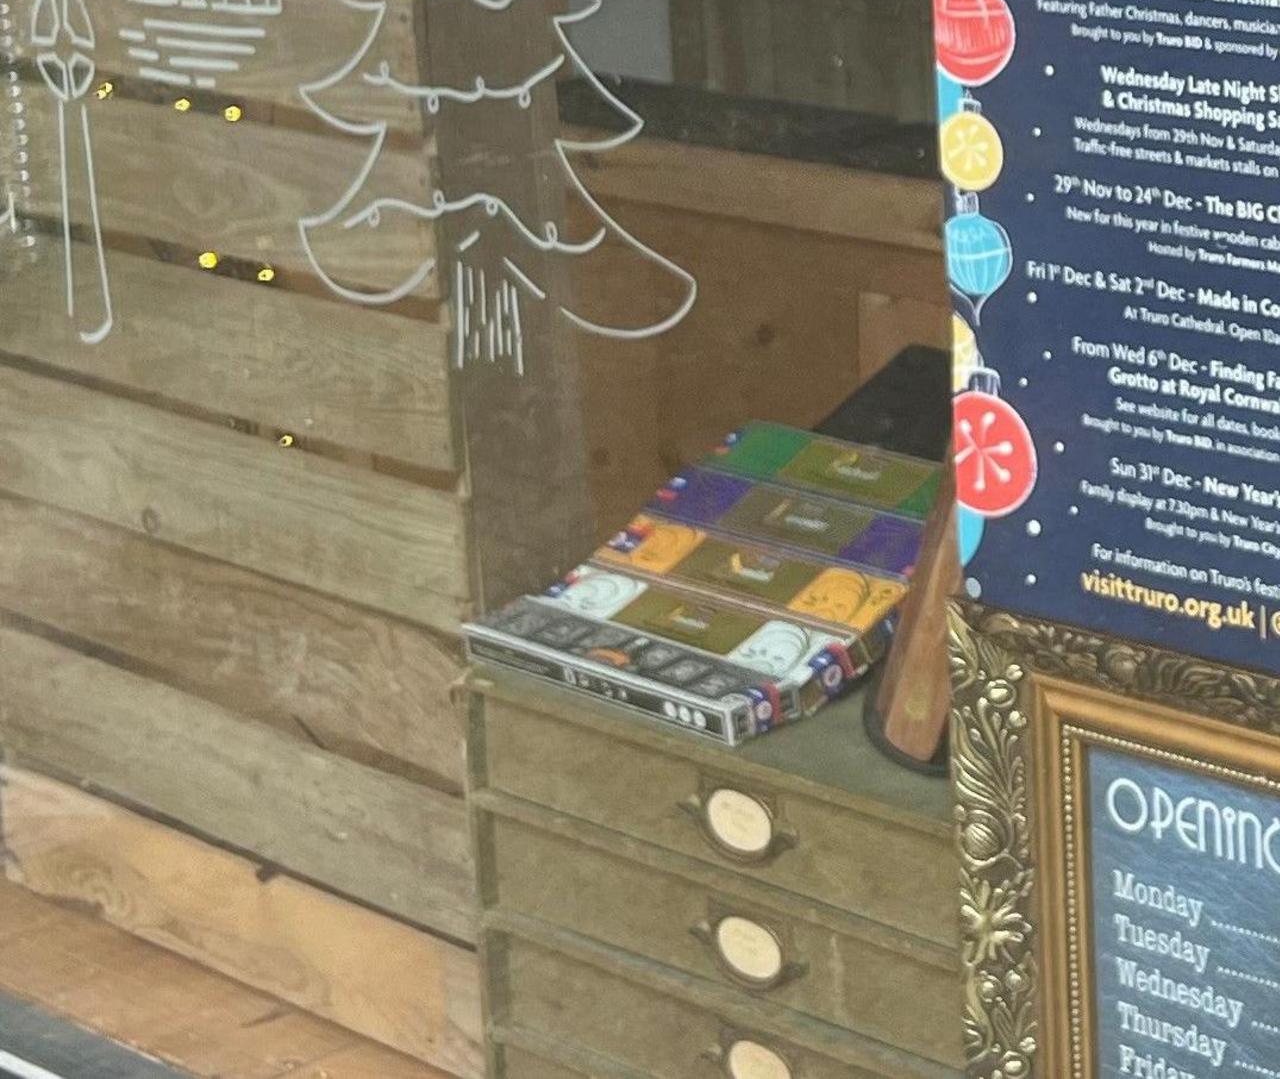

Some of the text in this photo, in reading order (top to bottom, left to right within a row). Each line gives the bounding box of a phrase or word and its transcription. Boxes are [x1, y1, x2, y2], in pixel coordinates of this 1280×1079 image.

[1087, 0, 1124, 19] Father
[1099, 64, 1186, 97] Wednesday
[1186, 74, 1221, 97] Late
[1222, 78, 1267, 105] Night
[1073, 115, 1142, 141] Wednesdays
[1141, 122, 1171, 141] from
[1171, 127, 1199, 145] 29th
[1199, 131, 1225, 148] Nov
[1225, 134, 1237, 151] &
[1101, 88, 1115, 109] &
[1115, 90, 1192, 118] Christmas
[1192, 99, 1266, 132] Shopping
[1054, 173, 1081, 194] 29th
[1082, 178, 1113, 199] Nov
[1113, 184, 1133, 203] to
[1134, 184, 1162, 205] 24th
[1162, 188, 1193, 212] Dec
[1203, 194, 1235, 217] The
[1235, 199, 1265, 222] BIG
[1026, 260, 1046, 280] Fri
[1062, 265, 1092, 288] Dec
[1093, 270, 1107, 290] &
[1107, 272, 1132, 293] Sat
[1155, 279, 1186, 303] Dec
[1196, 286, 1241, 311] Made
[1241, 293, 1258, 314] in
[1071, 335, 1110, 359] From
[1111, 342, 1146, 366] Wed
[1146, 348, 1167, 368] 6th
[1167, 351, 1199, 375] Dec
[1208, 359, 1265, 392] Finding
[1107, 365, 1159, 392] Grotto
[1160, 377, 1178, 395] at
[1177, 378, 1222, 405] Royal
[1109, 456, 1137, 479] Sun
[1161, 466, 1193, 491] Dec
[1202, 475, 1240, 499] New
[1091, 542, 1114, 562] For
[1113, 547, 1189, 579] information
[1187, 567, 1208, 583] on
[1080, 568, 1256, 630] visittruro.org.uk
[1113, 869, 1204, 928] Monday
[1113, 913, 1210, 973] Tuesday
[1115, 956, 1245, 1028] Wednesday
[1116, 1000, 1227, 1067] Thursday
